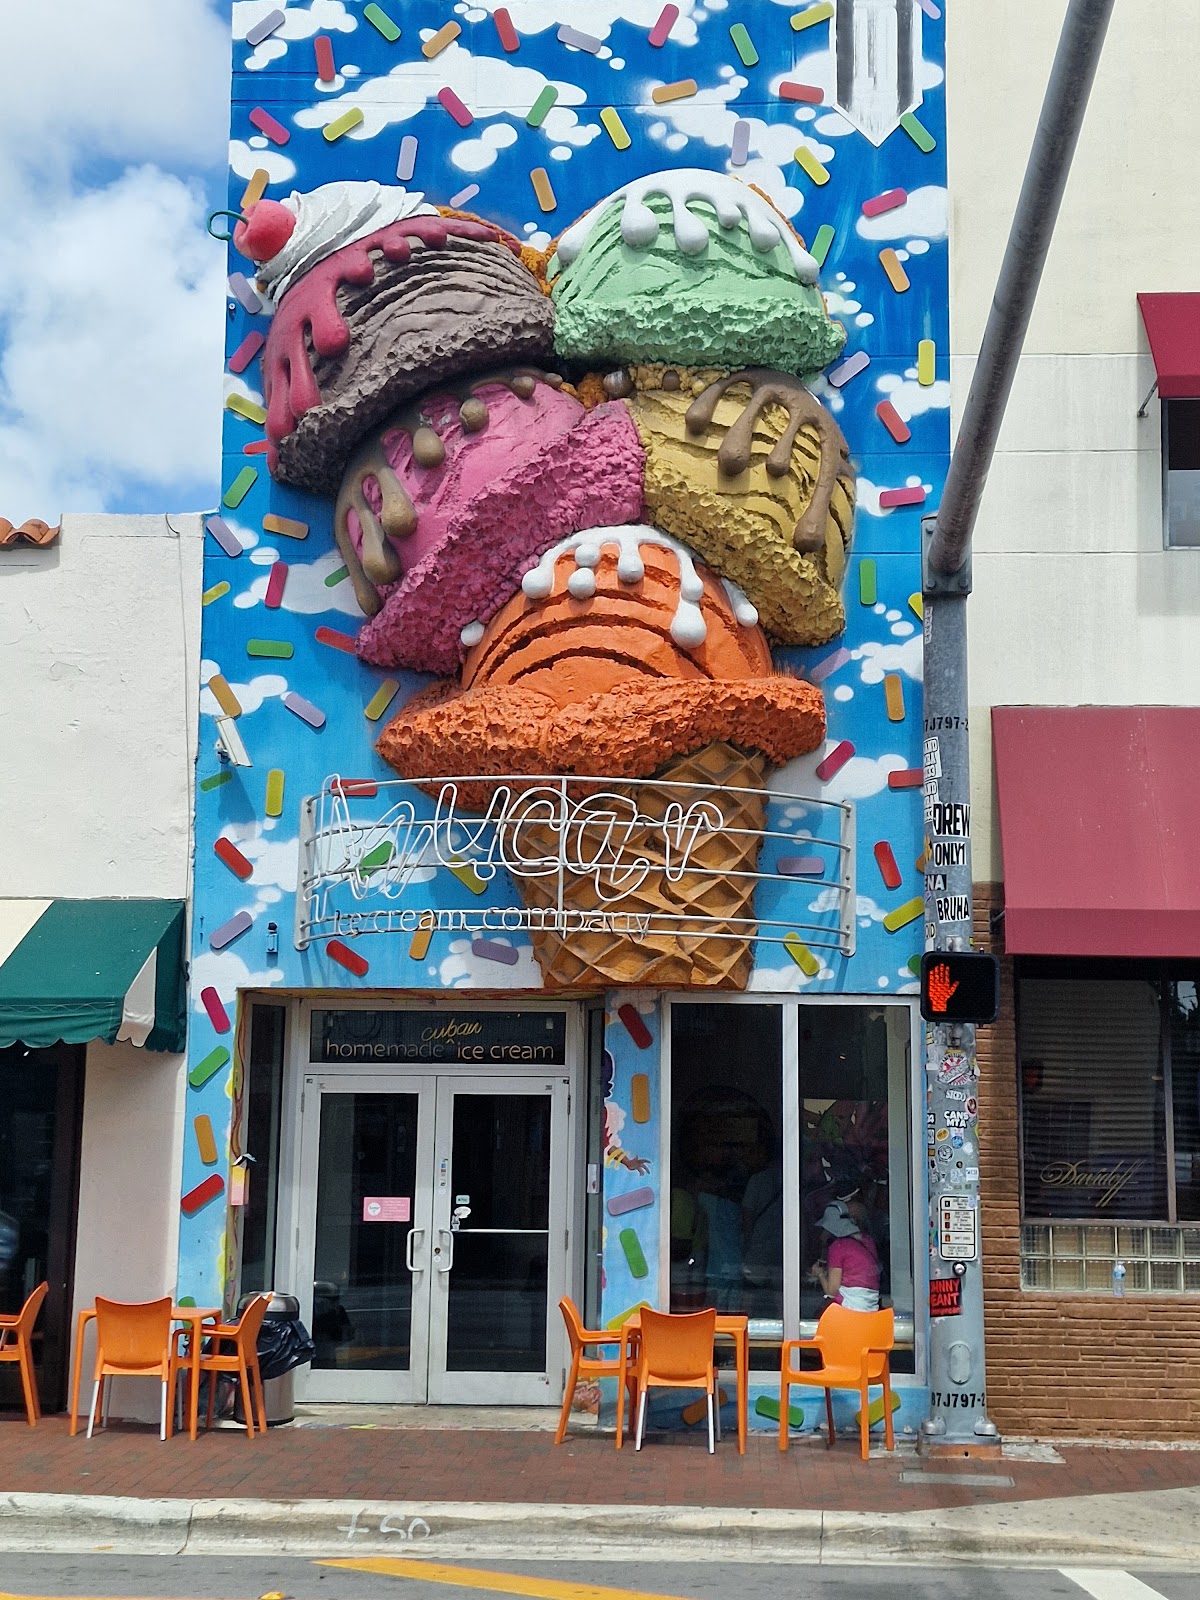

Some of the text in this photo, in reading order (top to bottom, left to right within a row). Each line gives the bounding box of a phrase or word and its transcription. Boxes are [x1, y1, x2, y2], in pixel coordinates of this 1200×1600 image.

[937, 897, 969, 921] BRUHA
[482, 906, 651, 943] company
[421, 1018, 482, 1041] cuban
[326, 1039, 554, 1060] homemade ice cream
